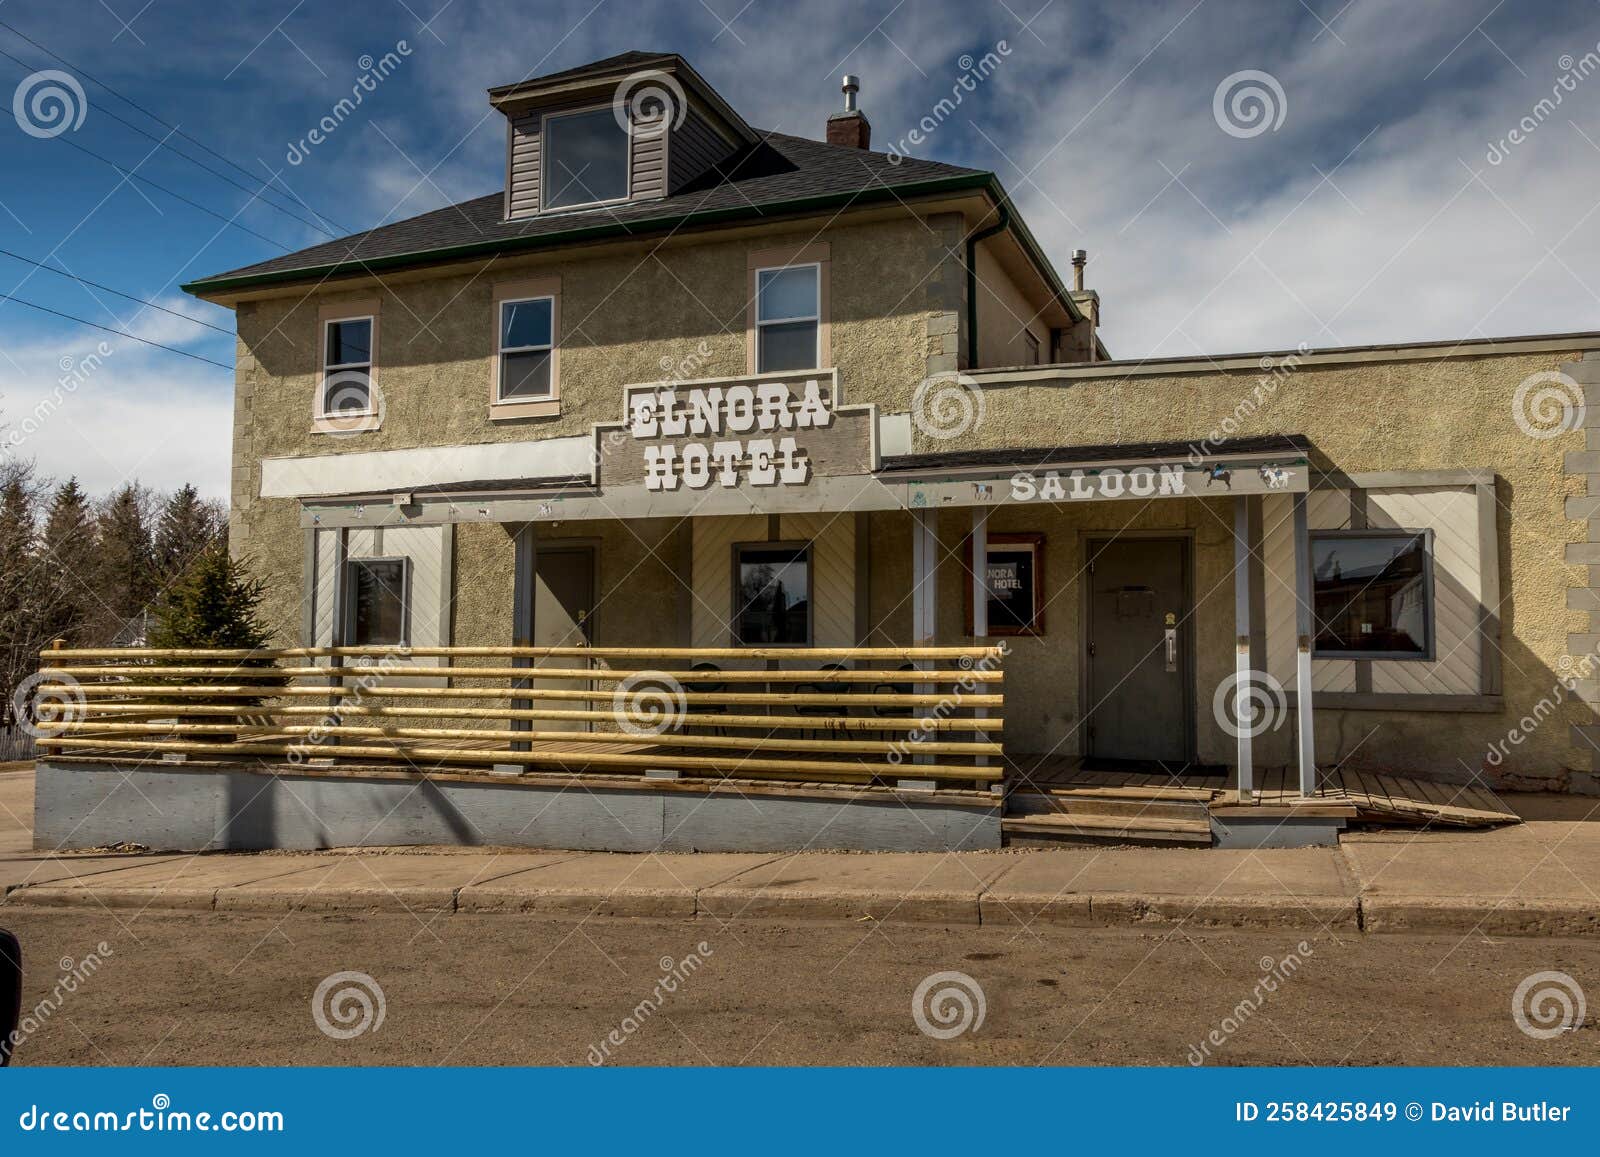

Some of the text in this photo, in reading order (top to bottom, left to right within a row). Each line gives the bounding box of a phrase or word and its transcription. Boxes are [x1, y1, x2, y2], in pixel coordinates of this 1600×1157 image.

[630, 380, 830, 437] ELNORA
[644, 438, 808, 489] HOTEL
[1010, 464, 1184, 500] SALOON
[994, 579, 1022, 590] HOTEL
